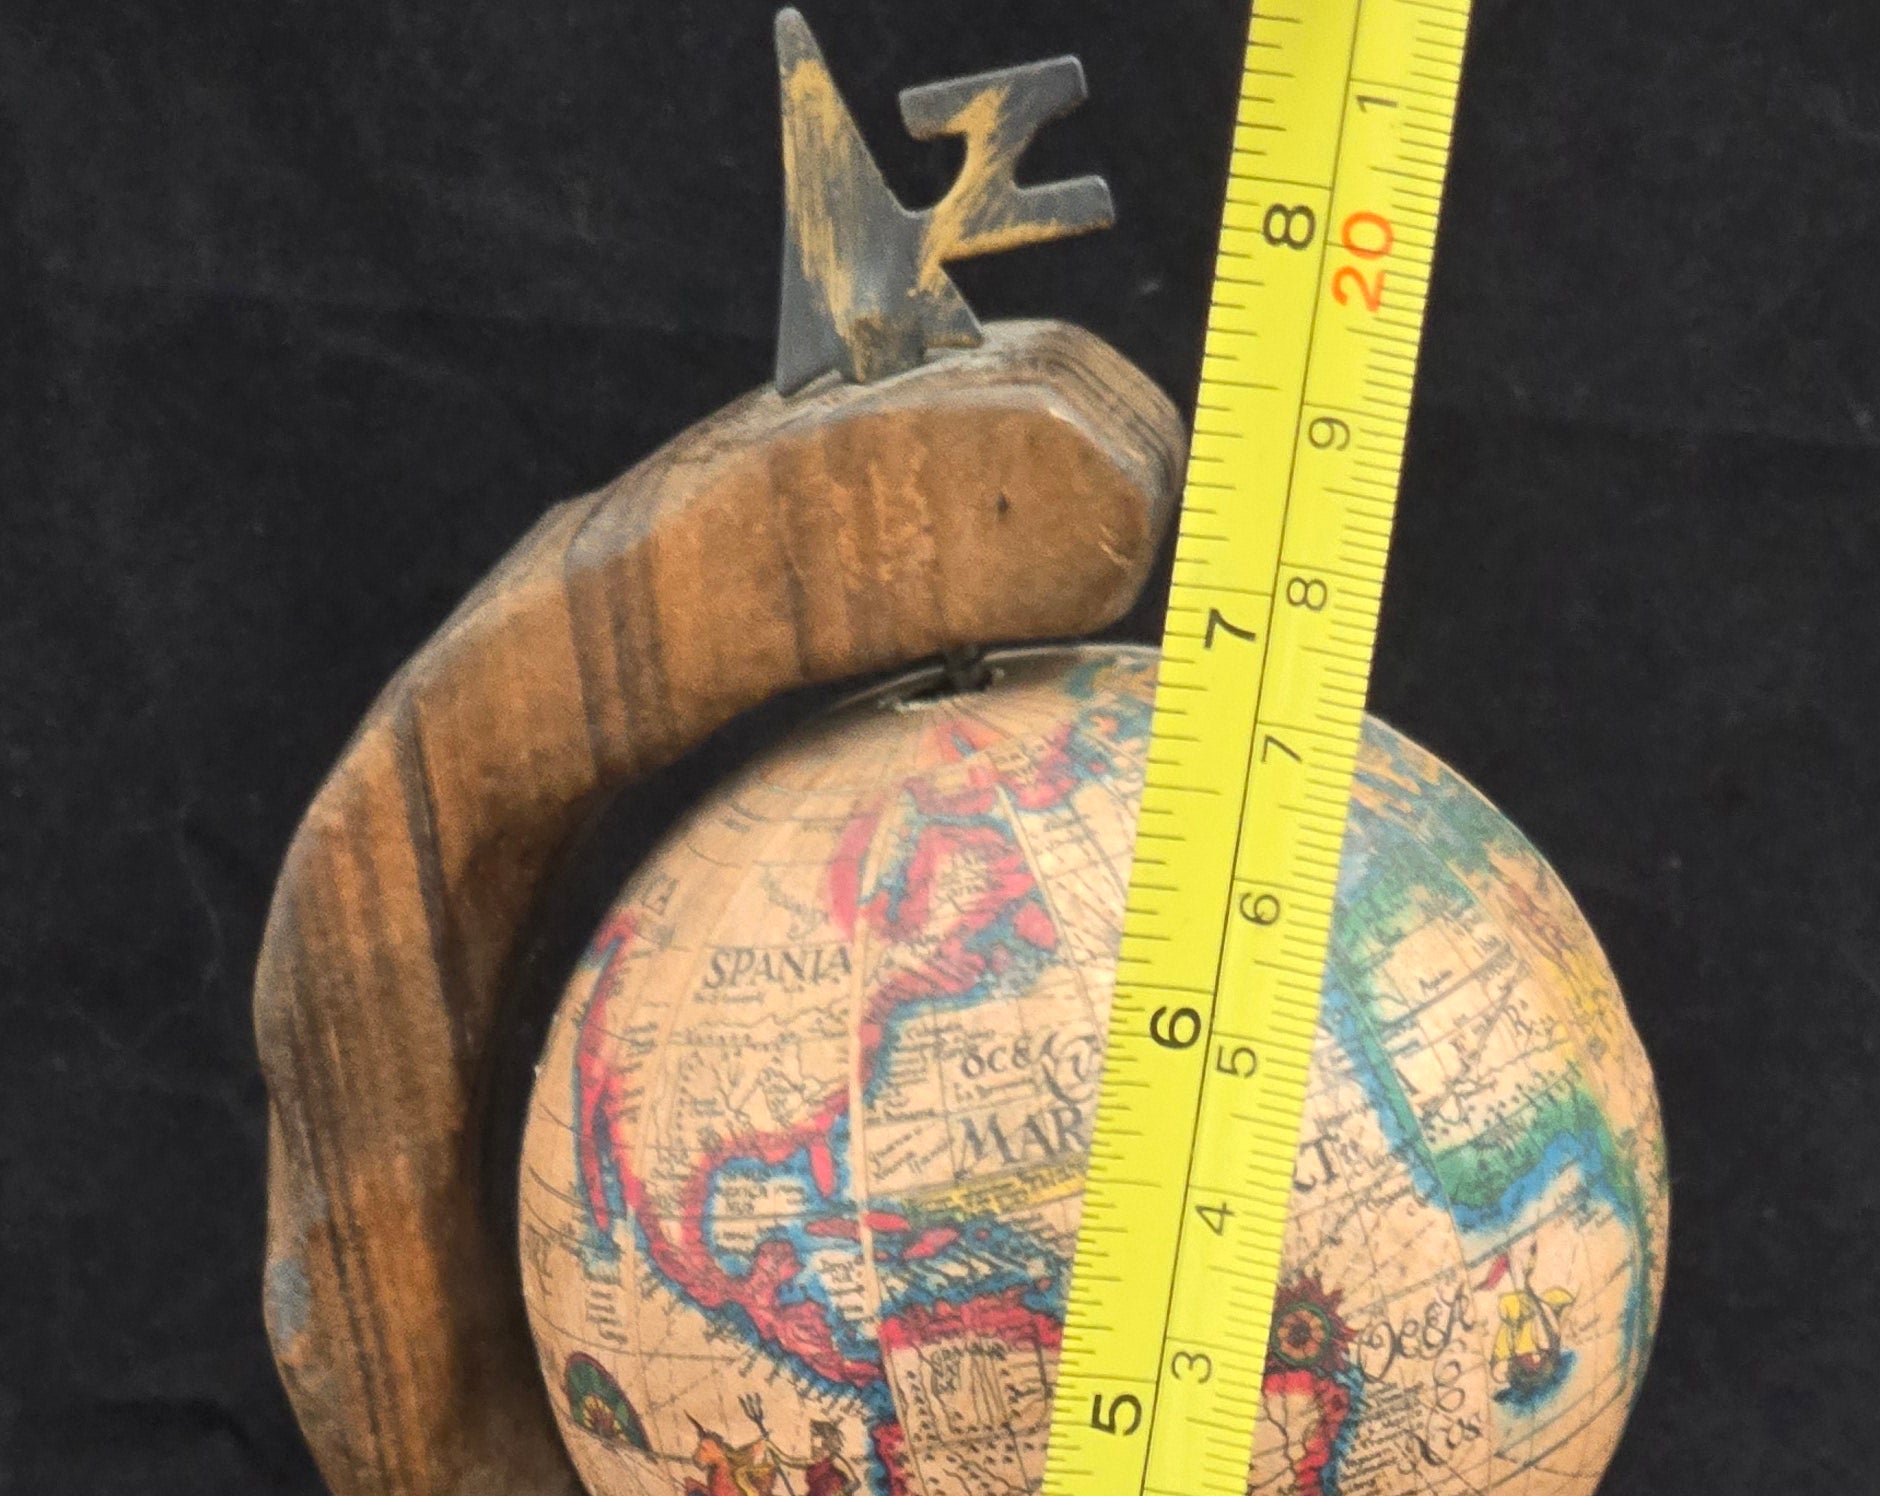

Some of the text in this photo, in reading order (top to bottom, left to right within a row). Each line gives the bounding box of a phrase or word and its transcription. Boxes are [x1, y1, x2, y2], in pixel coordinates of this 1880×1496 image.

[1356, 93, 1398, 112] 1
[1262, 204, 1315, 250] 8
[1332, 212, 1394, 311] 20
[1308, 417, 1350, 450] 9
[1286, 577, 1327, 611] 8
[1204, 609, 1255, 648] 7
[1260, 733, 1303, 764] 7
[1240, 893, 1280, 925] 6
[1150, 1007, 1201, 1049] 6
[1217, 1043, 1258, 1078] 5
[1195, 1203, 1234, 1235] 4
[1171, 1351, 1211, 1383] 3
[1091, 1394, 1141, 1435] 5
